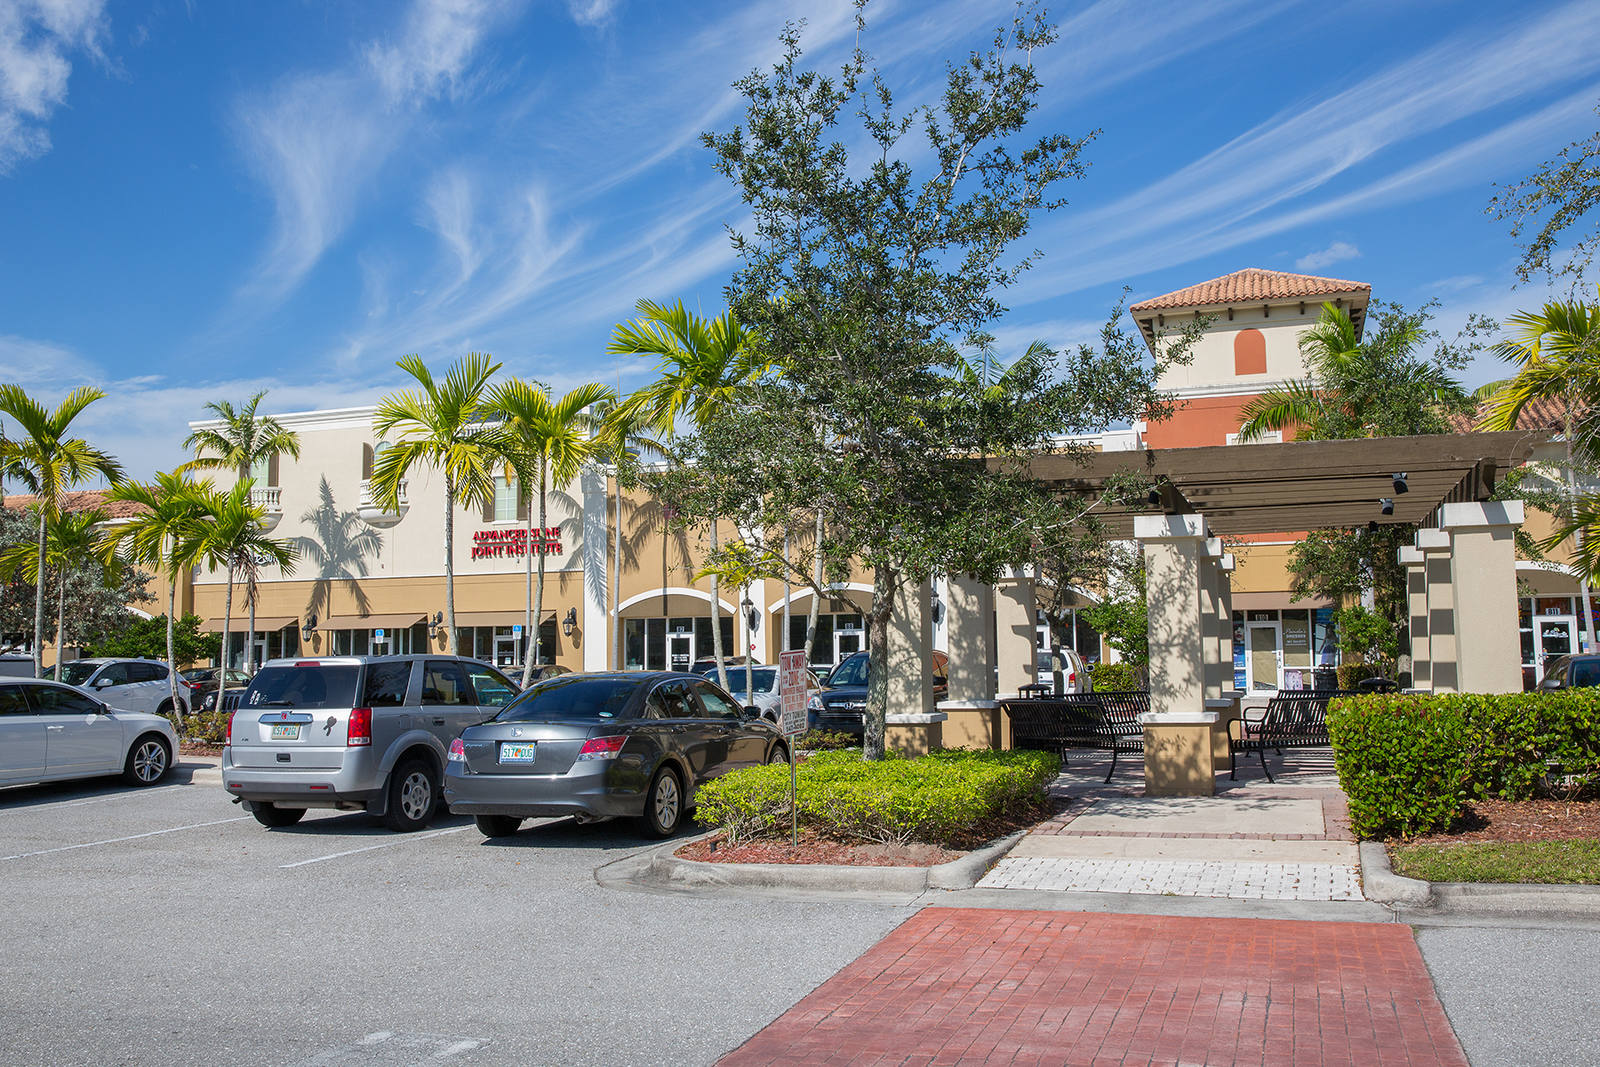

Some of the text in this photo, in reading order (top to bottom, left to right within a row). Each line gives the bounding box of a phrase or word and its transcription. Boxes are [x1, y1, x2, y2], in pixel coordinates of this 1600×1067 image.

[472, 528, 527, 541] ADVANCED
[471, 545, 504, 559] JOINT
[782, 653, 804, 671] TOW AWAY
[789, 670, 799, 686] ZONE
[503, 748, 515, 758] 517
